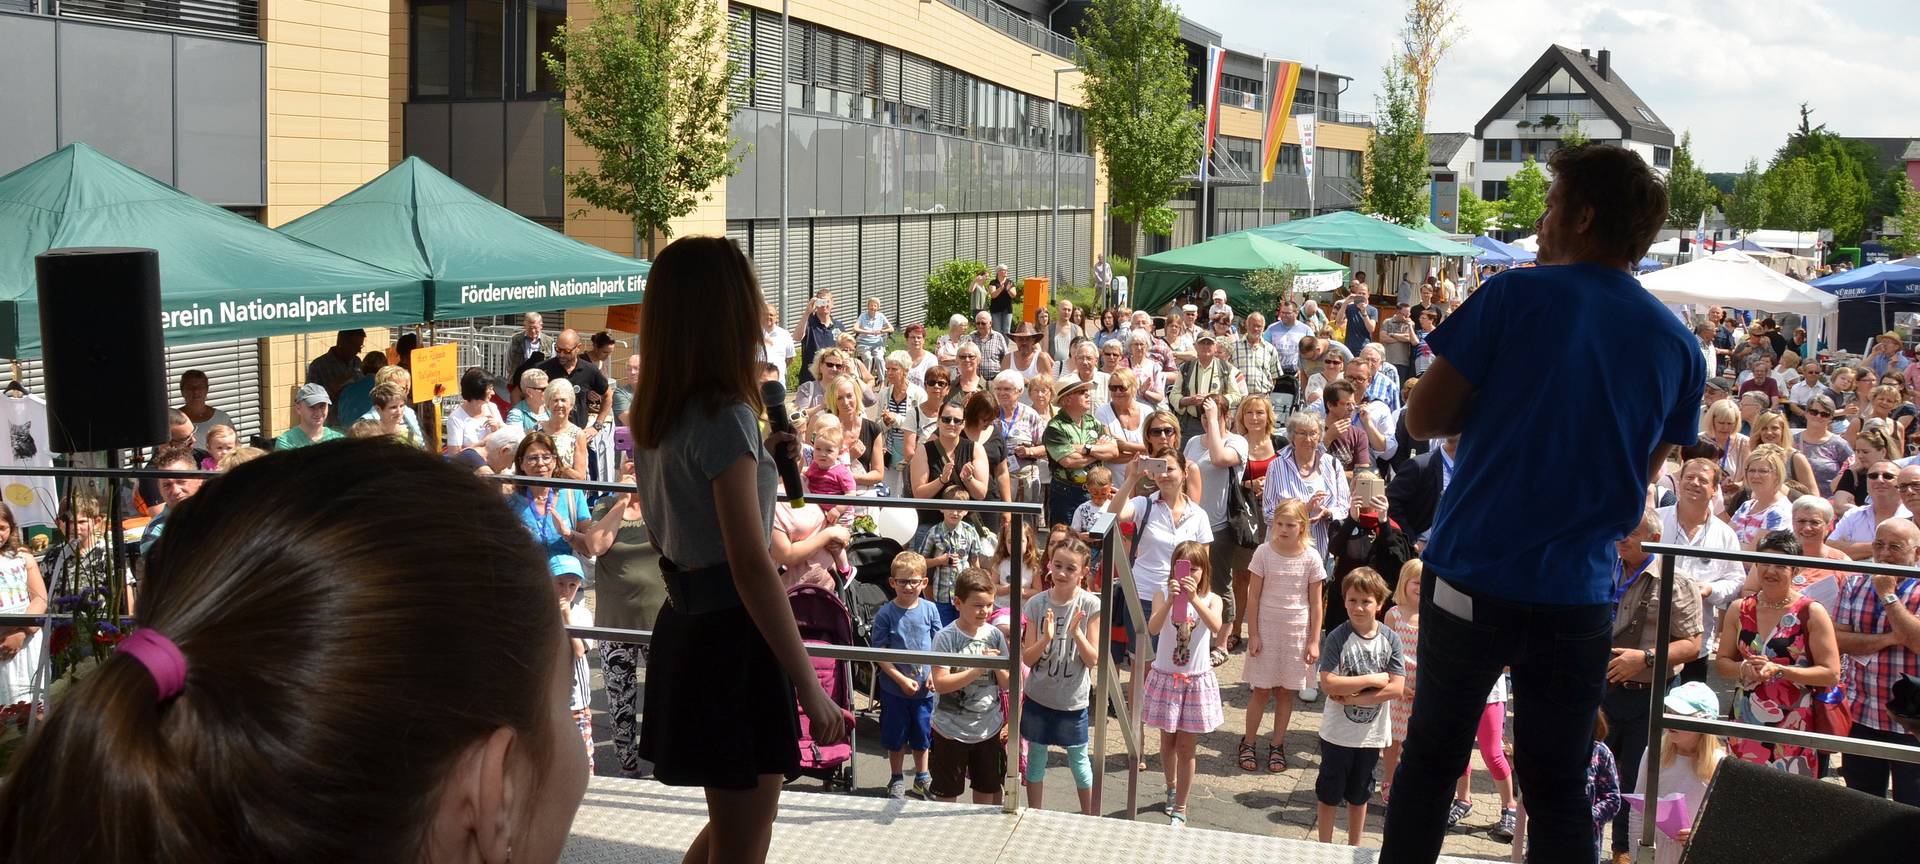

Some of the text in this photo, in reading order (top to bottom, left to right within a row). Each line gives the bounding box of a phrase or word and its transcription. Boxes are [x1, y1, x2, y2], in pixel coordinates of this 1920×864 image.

[461, 275, 647, 304] Förderverein Nationalpark Eife
[161, 291, 390, 329] erein Nationalpark Eifel
